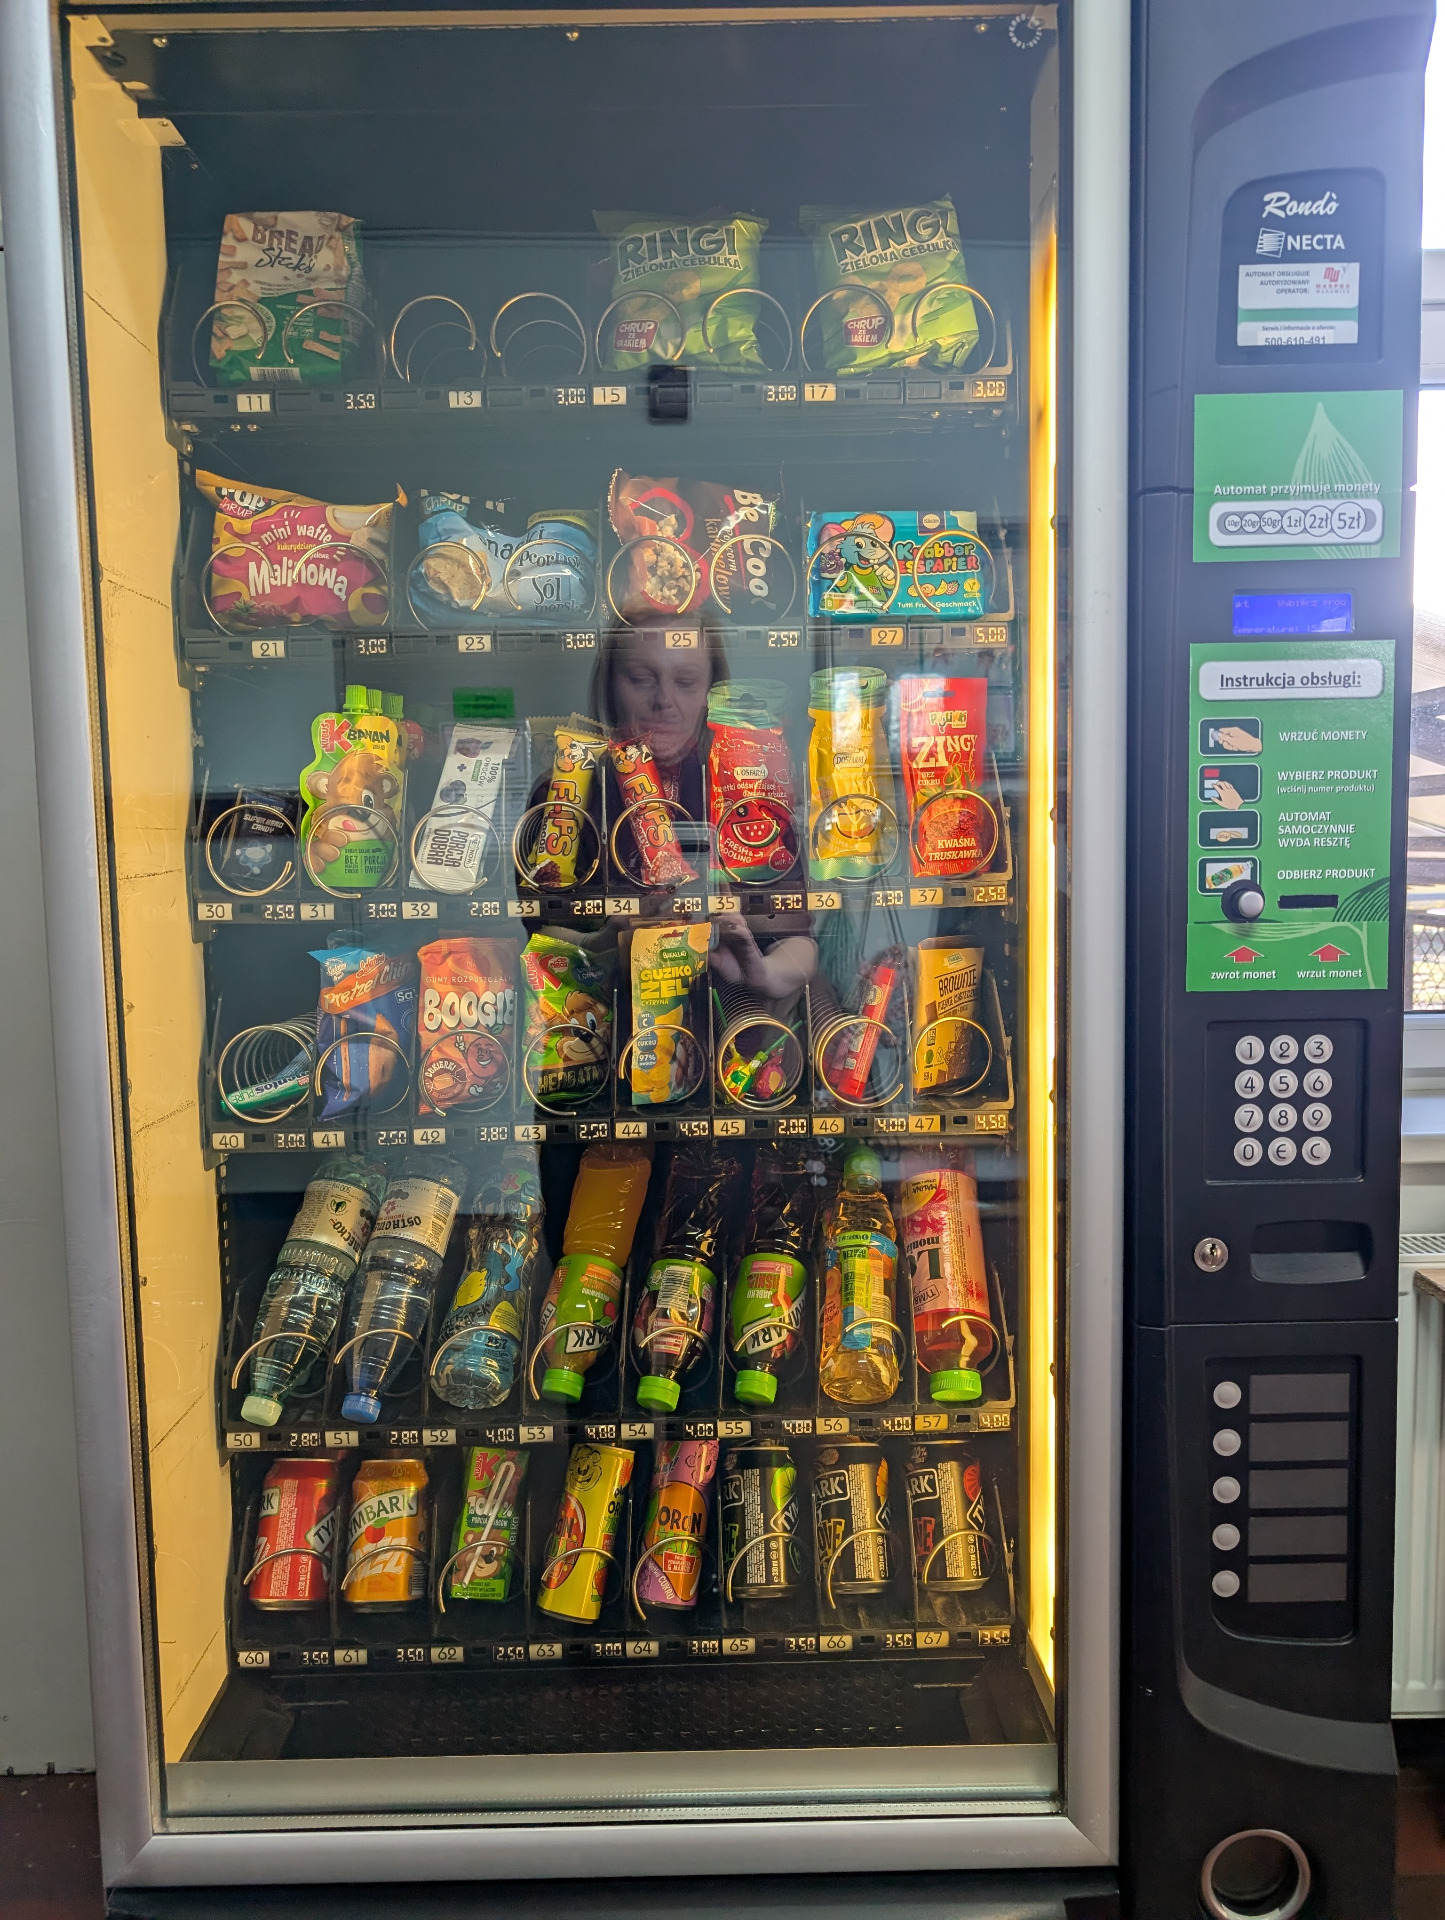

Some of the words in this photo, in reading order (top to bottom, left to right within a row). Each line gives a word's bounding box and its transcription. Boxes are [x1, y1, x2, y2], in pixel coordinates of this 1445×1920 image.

[829, 209, 950, 262] RINGI
[1287, 234, 1345, 250] NECTA
[618, 226, 738, 273] RINGI
[839, 249, 899, 274] ZIELONA
[901, 238, 959, 259] CEBULKA
[255, 247, 316, 274] Sticks
[621, 260, 679, 284] ZIELONA
[682, 255, 743, 271] CEBULKA
[619, 320, 655, 335] CHRUP
[848, 316, 884, 330] CHRUP
[1264, 335, 1326, 345] 500-610-491
[454, 391, 473, 406] 13
[600, 388, 620, 402] 15
[810, 385, 827, 399] 17
[247, 396, 264, 411] 11
[1213, 485, 1267, 496] Automat
[1270, 483, 1331, 496] przyjmuje
[1334, 482, 1381, 494] monety
[734, 489, 763, 522] Be
[1227, 519, 1240, 527] 10gr
[1243, 518, 1260, 528] 20gr
[1262, 517, 1282, 529] 50gr
[1286, 515, 1302, 527] 1zł
[1309, 513, 1329, 528] 2zł
[1337, 511, 1362, 529] 5zł
[261, 521, 291, 545] mini
[297, 523, 332, 543] wafle
[249, 557, 348, 602] Malinowa
[533, 578, 561, 604] Sól
[465, 637, 485, 650] 23
[672, 633, 692, 647] 25
[877, 630, 898, 644] 27
[260, 643, 278, 656] 21
[1220, 672, 1295, 690] Instrukcja
[1300, 670, 1361, 689] obsługi:
[348, 728, 390, 744] BANAN
[1279, 729, 1318, 742] WRZUĆ
[1321, 730, 1368, 741] MONETY
[912, 735, 977, 768] ZINGY
[487, 763, 500, 783] 100%
[1277, 770, 1324, 781] WYBIERZ
[1327, 769, 1378, 780] PRODUKT
[918, 778, 940, 786] CUKRU
[1277, 784, 1307, 794] (wciśnij
[1309, 785, 1333, 793] numer
[1335, 783, 1375, 794] produktu)
[243, 813, 266, 824] SUPER
[1278, 811, 1331, 822] AUTOMAT
[251, 823, 274, 834] CANDY
[1278, 824, 1355, 834] SAMOCZYNNIE
[427, 829, 451, 866] DOBRA
[450, 830, 469, 868] PORCJA
[724, 838, 748, 856] FRESH
[938, 838, 976, 849] KWAŚNA
[1278, 838, 1310, 848] WYDA
[1313, 837, 1351, 849] RESZTĘ
[344, 855, 358, 865] BEZ
[928, 849, 984, 861] TRUSKAWKA
[1277, 869, 1323, 880] ODBIERZ
[1325, 868, 1376, 879] PRODUKT
[816, 894, 835, 907] 36
[919, 890, 937, 902] 37
[410, 903, 430, 917] 32
[515, 901, 534, 914] 33
[612, 901, 632, 913] 34
[715, 897, 735, 910] 35
[206, 905, 225, 918] 30
[309, 905, 327, 917] 31
[1211, 970, 1240, 980] zwrot
[1242, 969, 1276, 979] monet
[1296, 968, 1326, 978] wrzut
[1328, 967, 1362, 978] monet
[938, 969, 977, 997] BROWNIE
[324, 973, 378, 1009] Pretzel
[641, 998, 669, 1007] CYTRYNA
[1246, 1042, 1252, 1058] 1
[1279, 1041, 1290, 1058] 2
[1313, 1041, 1324, 1057] 3
[639, 1054, 656, 1062] 97%
[1244, 1076, 1255, 1092] 4
[1278, 1076, 1289, 1092] 5
[1312, 1076, 1324, 1091] 6
[1244, 1110, 1255, 1126] 7
[1277, 1109, 1289, 1126] 8
[1311, 1109, 1323, 1125] 9
[622, 1125, 642, 1136] 44
[720, 1122, 740, 1134] 45
[819, 1119, 839, 1132] 46
[915, 1118, 934, 1131] 47
[321, 1134, 339, 1146] 41
[420, 1130, 440, 1143] 42
[521, 1127, 541, 1140] 43
[219, 1135, 239, 1148] 40
[1243, 1144, 1254, 1160] 0
[1310, 1143, 1320, 1159] C
[912, 1183, 938, 1194] MALINA
[824, 1420, 842, 1431] 56
[923, 1416, 941, 1427] 57
[527, 1427, 546, 1440] 53
[628, 1425, 647, 1437] 54
[725, 1423, 744, 1435] 55
[234, 1434, 252, 1446] 50
[334, 1432, 351, 1445] 51
[430, 1430, 448, 1442] 52
[827, 1637, 846, 1648] 66
[924, 1632, 942, 1644] 67
[536, 1644, 555, 1656] 63
[633, 1642, 652, 1654] 64
[729, 1639, 749, 1651] 65
[245, 1653, 264, 1665] 60
[343, 1650, 360, 1662] 61
[438, 1648, 457, 1660] 62
